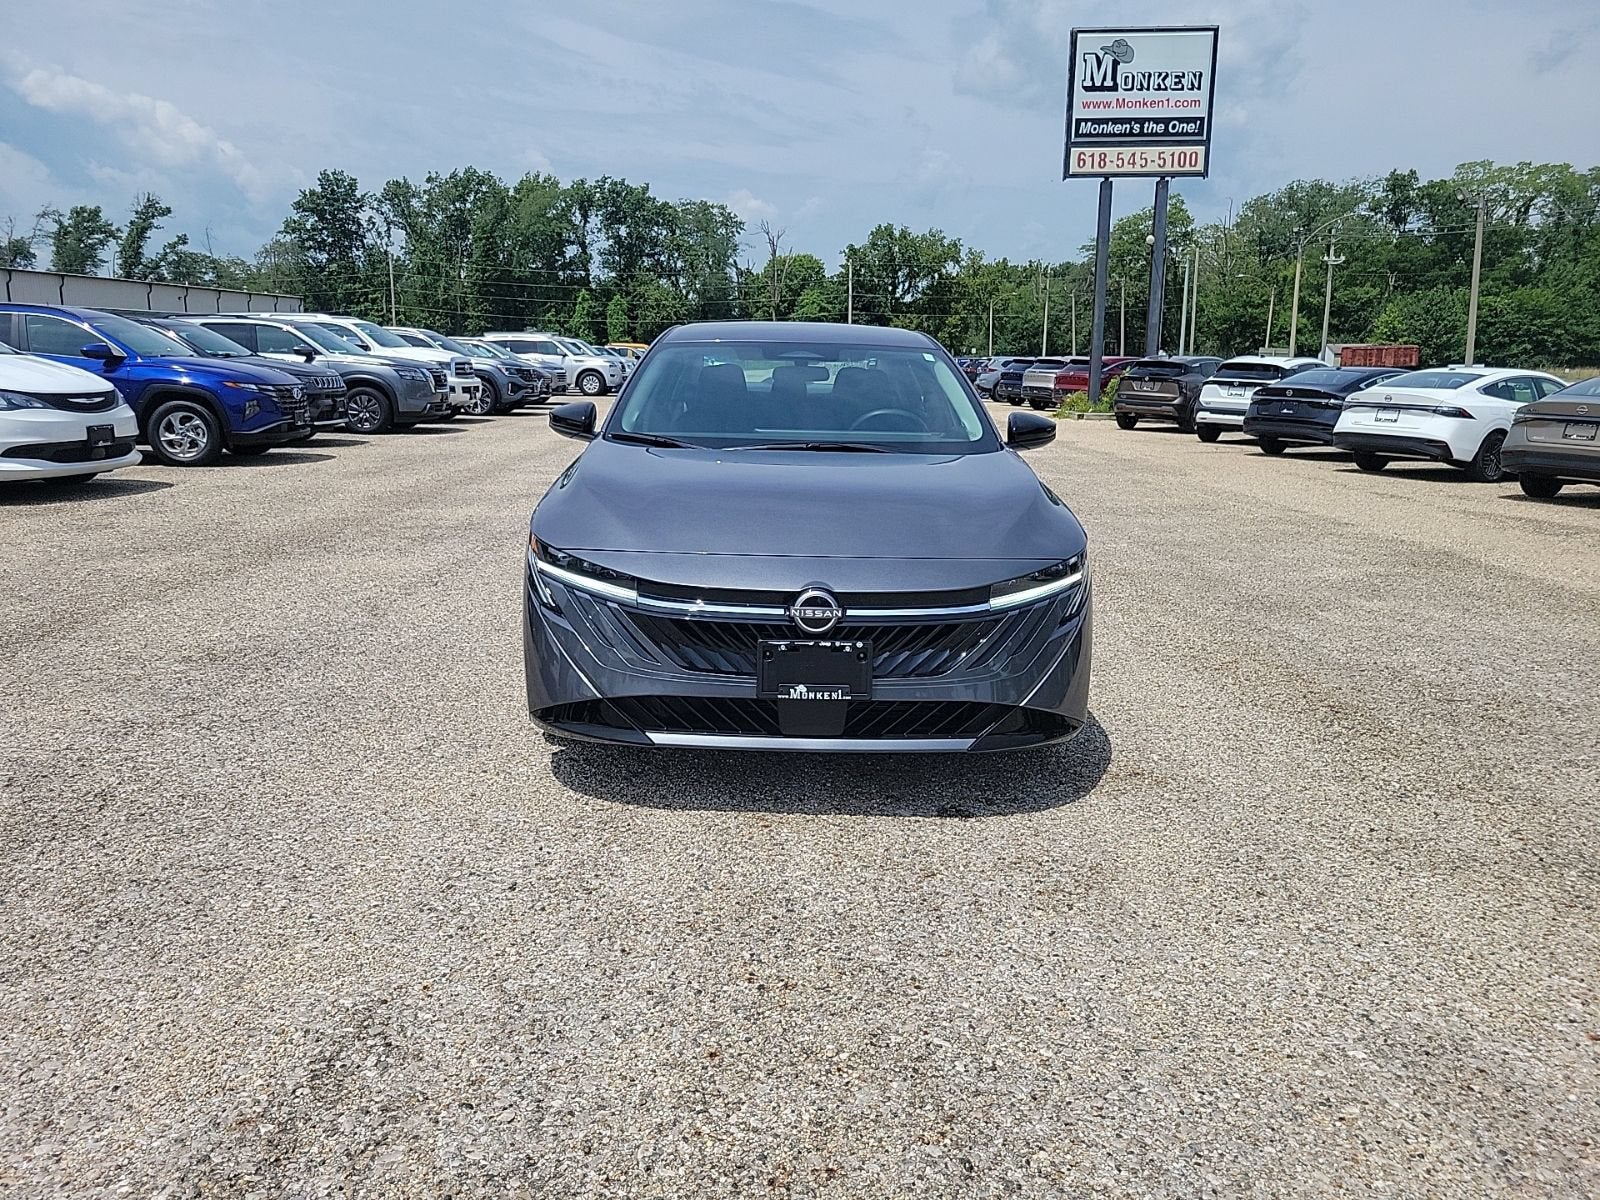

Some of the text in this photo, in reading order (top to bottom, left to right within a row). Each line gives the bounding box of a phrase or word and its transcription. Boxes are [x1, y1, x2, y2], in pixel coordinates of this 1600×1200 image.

[1082, 97, 1201, 110] www.Monken1.com
[1079, 120, 1200, 134] Monken's the One!
[1077, 150, 1199, 169] 618-545-5100
[791, 609, 842, 617] NISSAN
